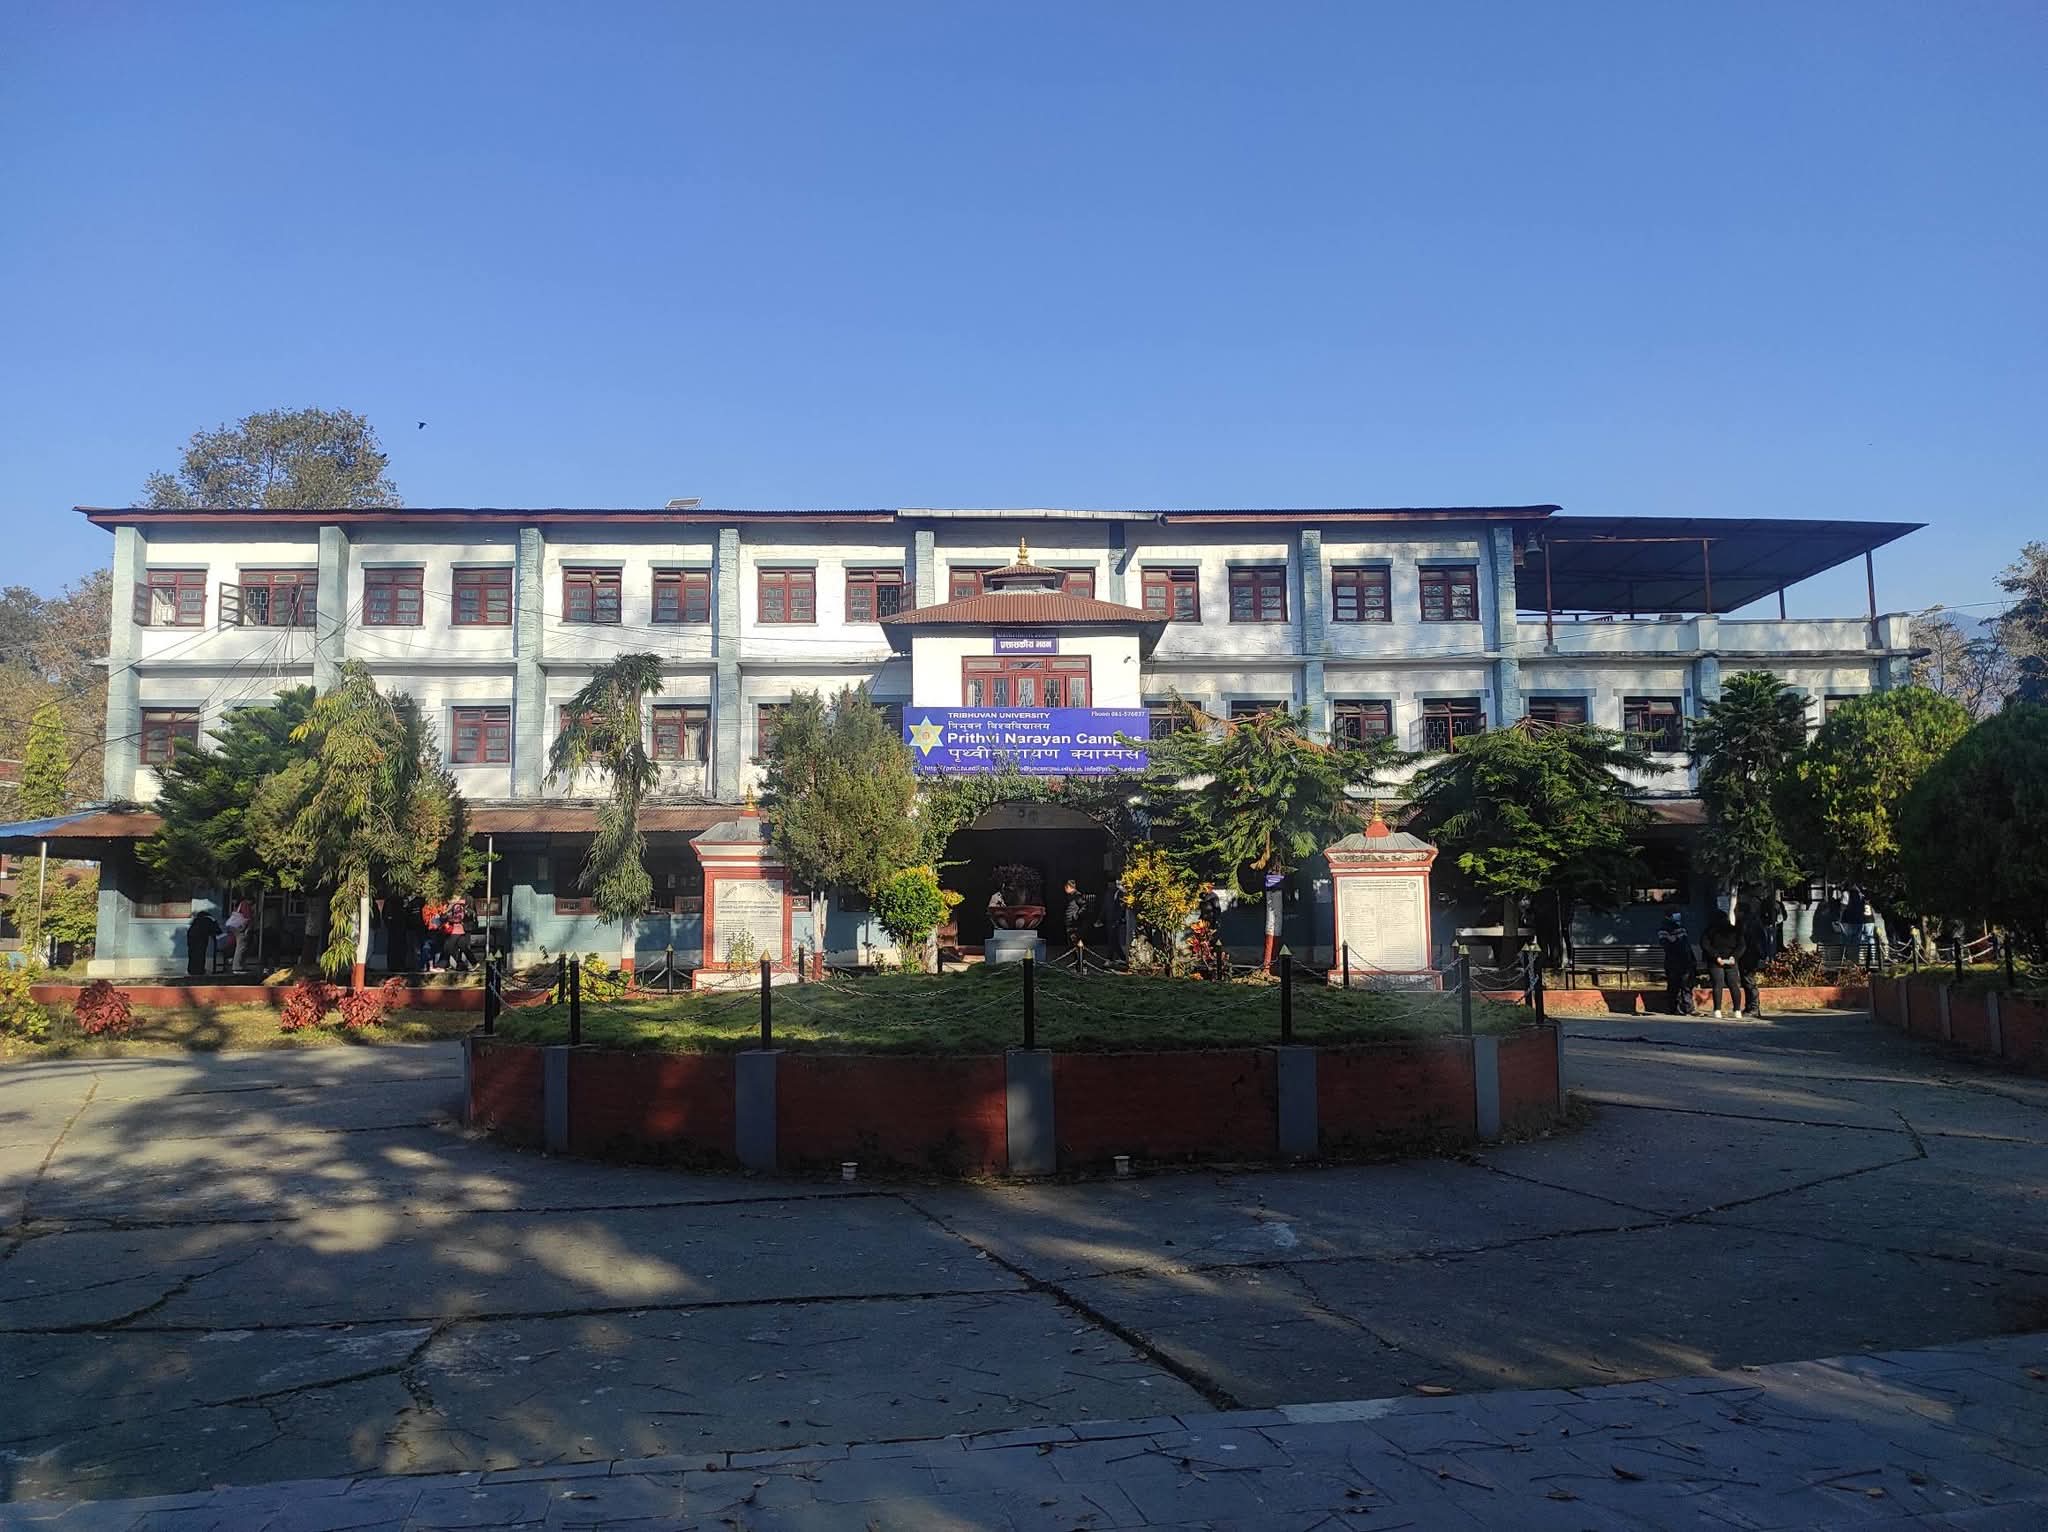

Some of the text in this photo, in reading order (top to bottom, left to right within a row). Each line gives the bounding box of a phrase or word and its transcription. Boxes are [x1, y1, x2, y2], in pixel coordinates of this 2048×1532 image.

[948, 720, 982, 731] त्रिभुवन
[947, 732, 1142, 746] Prithvi Narayan Camps
